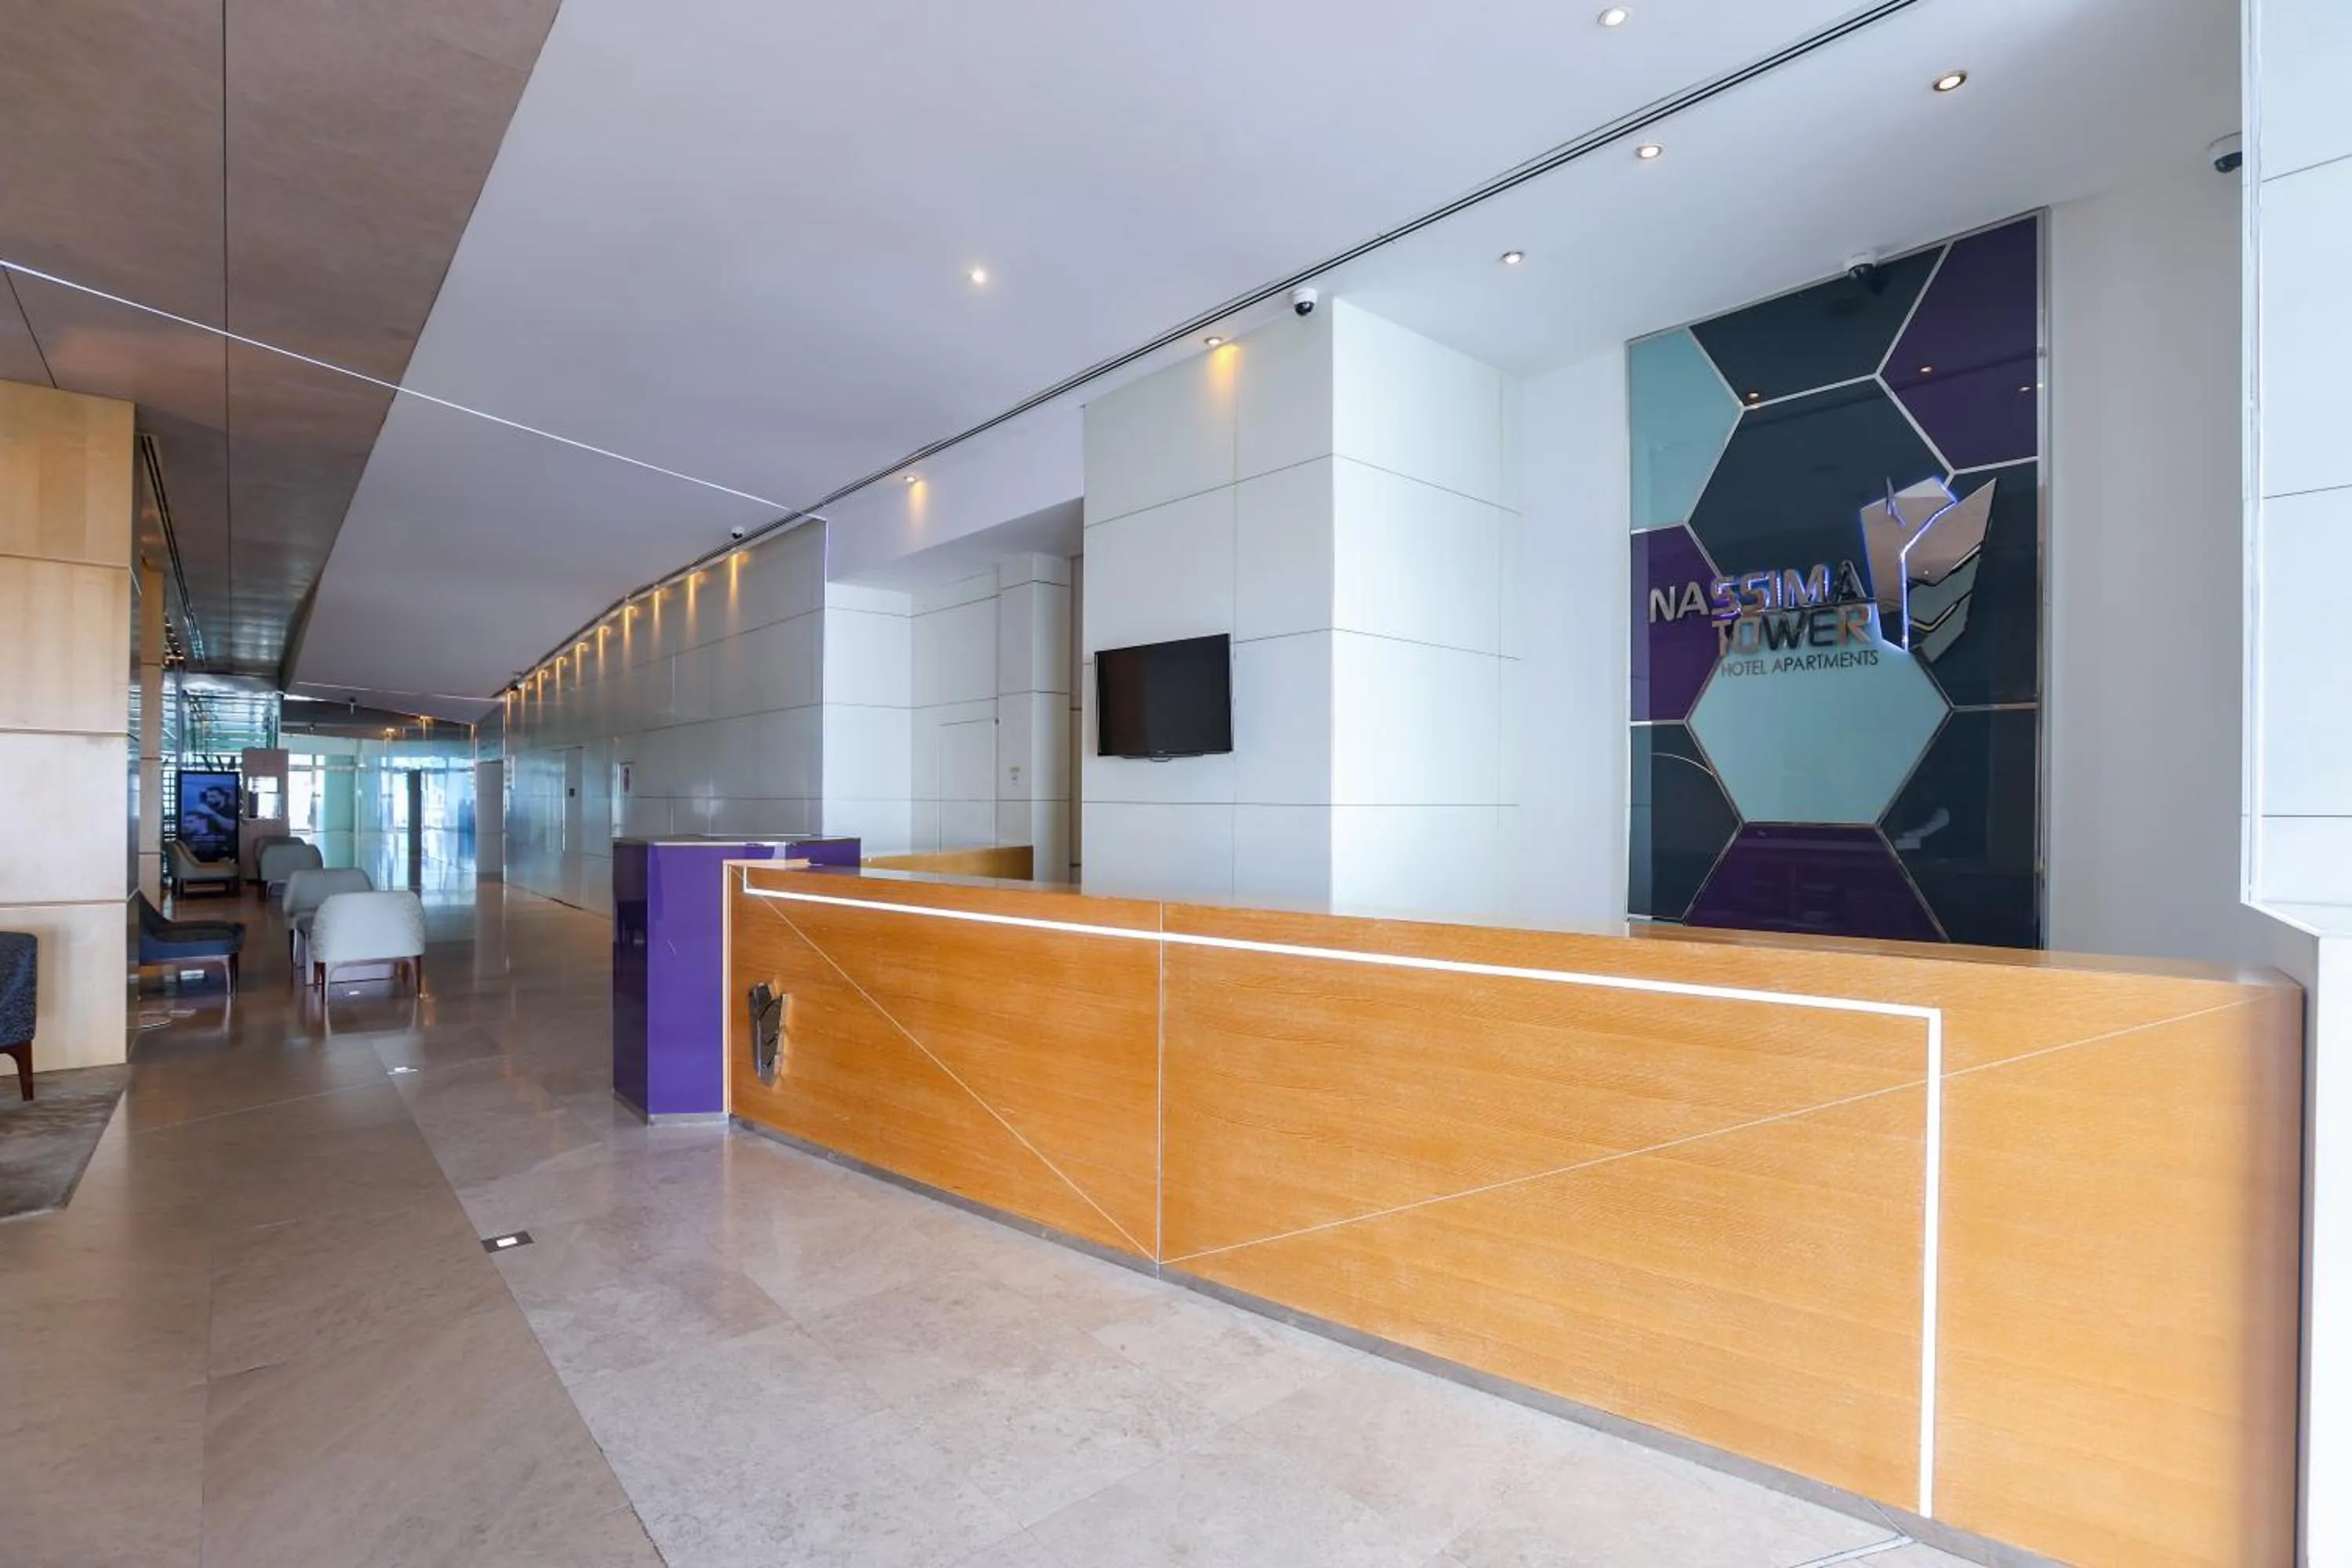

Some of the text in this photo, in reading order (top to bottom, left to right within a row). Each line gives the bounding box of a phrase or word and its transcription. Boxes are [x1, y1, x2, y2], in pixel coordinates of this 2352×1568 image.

[1650, 560, 1867, 623] NASSIMA
[1711, 603, 1873, 656] TOWER
[1721, 650, 1879, 678] HOTEL APARTMENTS
